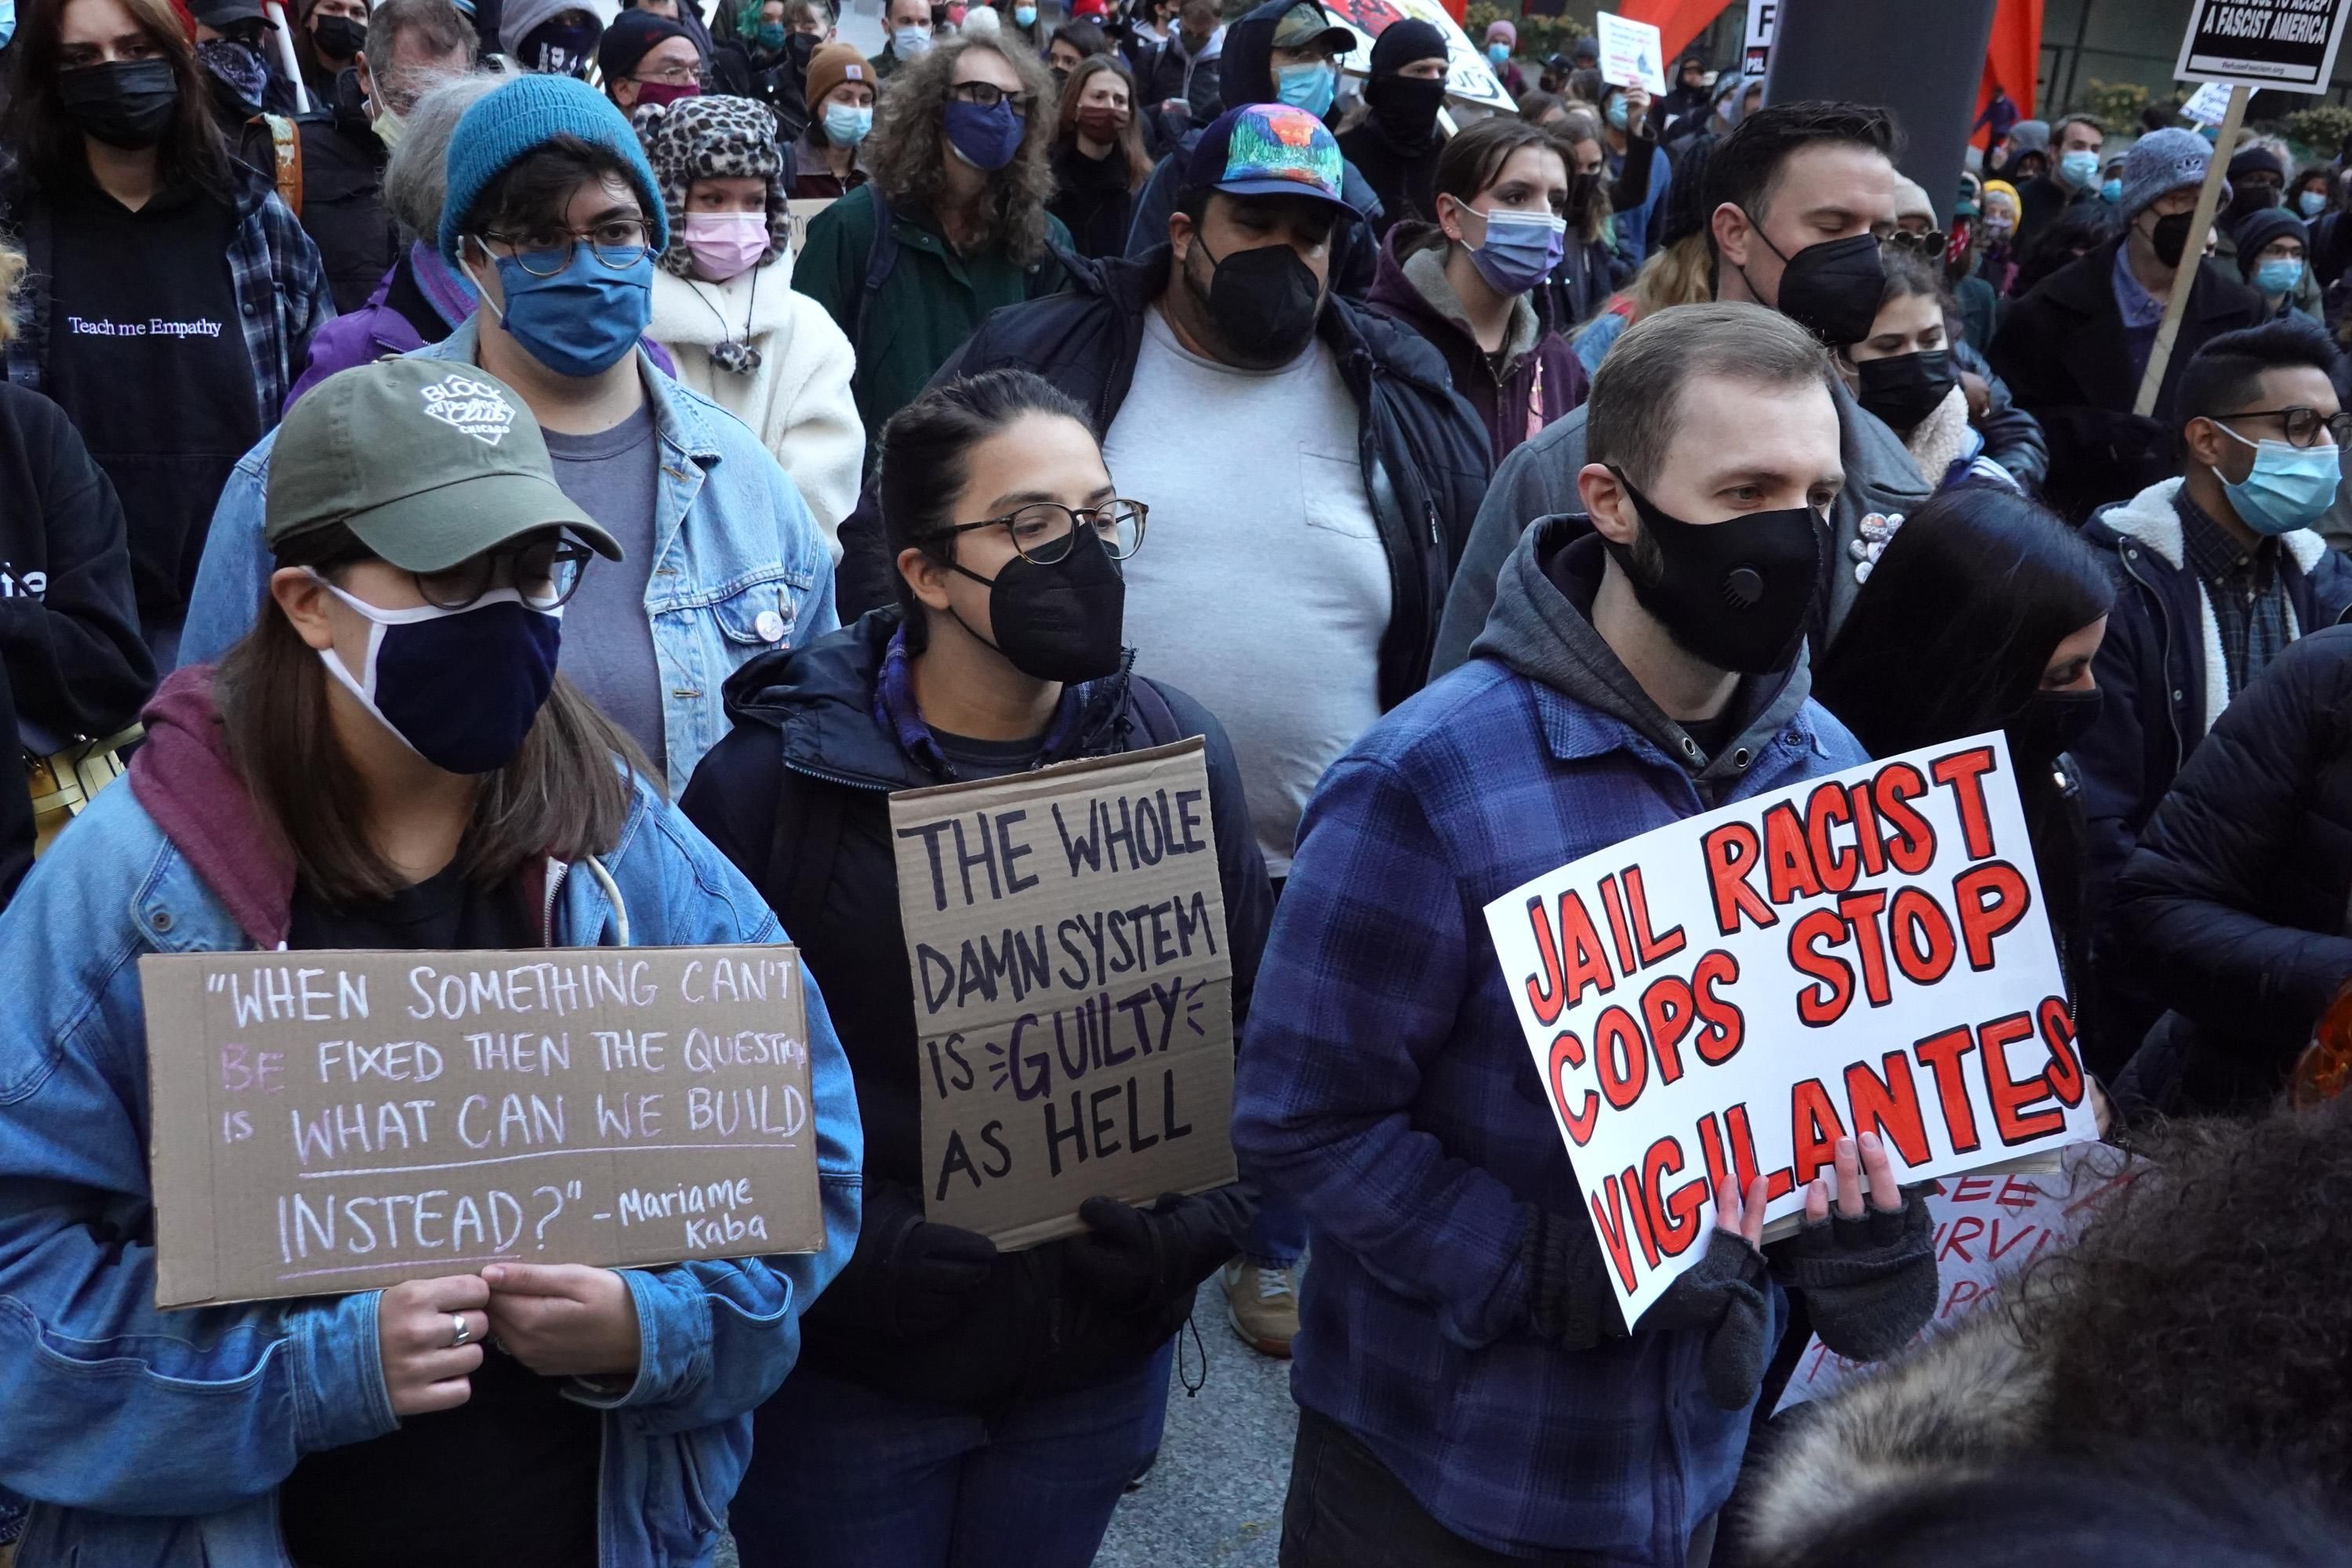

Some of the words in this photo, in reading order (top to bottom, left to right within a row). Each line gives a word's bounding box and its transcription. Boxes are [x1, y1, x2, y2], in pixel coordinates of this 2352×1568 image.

[2201, 5, 2216, 34] A
[2215, 7, 2273, 38] FASCIST
[2268, 12, 2328, 44] AMERICA
[68, 317, 115, 335] Teach
[118, 324, 146, 336] me
[149, 318, 222, 339] Empathy
[420, 381, 501, 401] BLOCK
[459, 424, 510, 434] CHICAGO
[897, 809, 1040, 911] THE
[1051, 789, 1207, 878] WHOLE
[1525, 864, 1687, 1027] JAIL
[1699, 745, 1996, 936] RACIST
[408, 961, 659, 1022] SOMETHING
[681, 958, 792, 1002] CAN'T
[916, 924, 1051, 1014] DAMN
[1058, 891, 1217, 991] SYSTEM
[927, 1033, 975, 1099] IS
[1009, 976, 1183, 1102] GUILTY
[1548, 948, 1745, 1147] COPS
[1787, 858, 2031, 1029] STOP
[220, 1042, 286, 1094] BE
[319, 1039, 444, 1085] FIXED
[464, 1030, 572, 1073] THEN
[590, 1029, 667, 1073] THE
[224, 1110, 254, 1143] IS
[291, 1099, 436, 1164] WHAT
[458, 1093, 568, 1149] CAN
[597, 1093, 665, 1139] WE
[688, 1084, 806, 1138] BUILD
[935, 1120, 1012, 1201] AS
[1044, 1069, 1193, 1178] HELL
[1591, 995, 2086, 1297] VIGILANTES
[686, 1215, 768, 1251] Kaba
